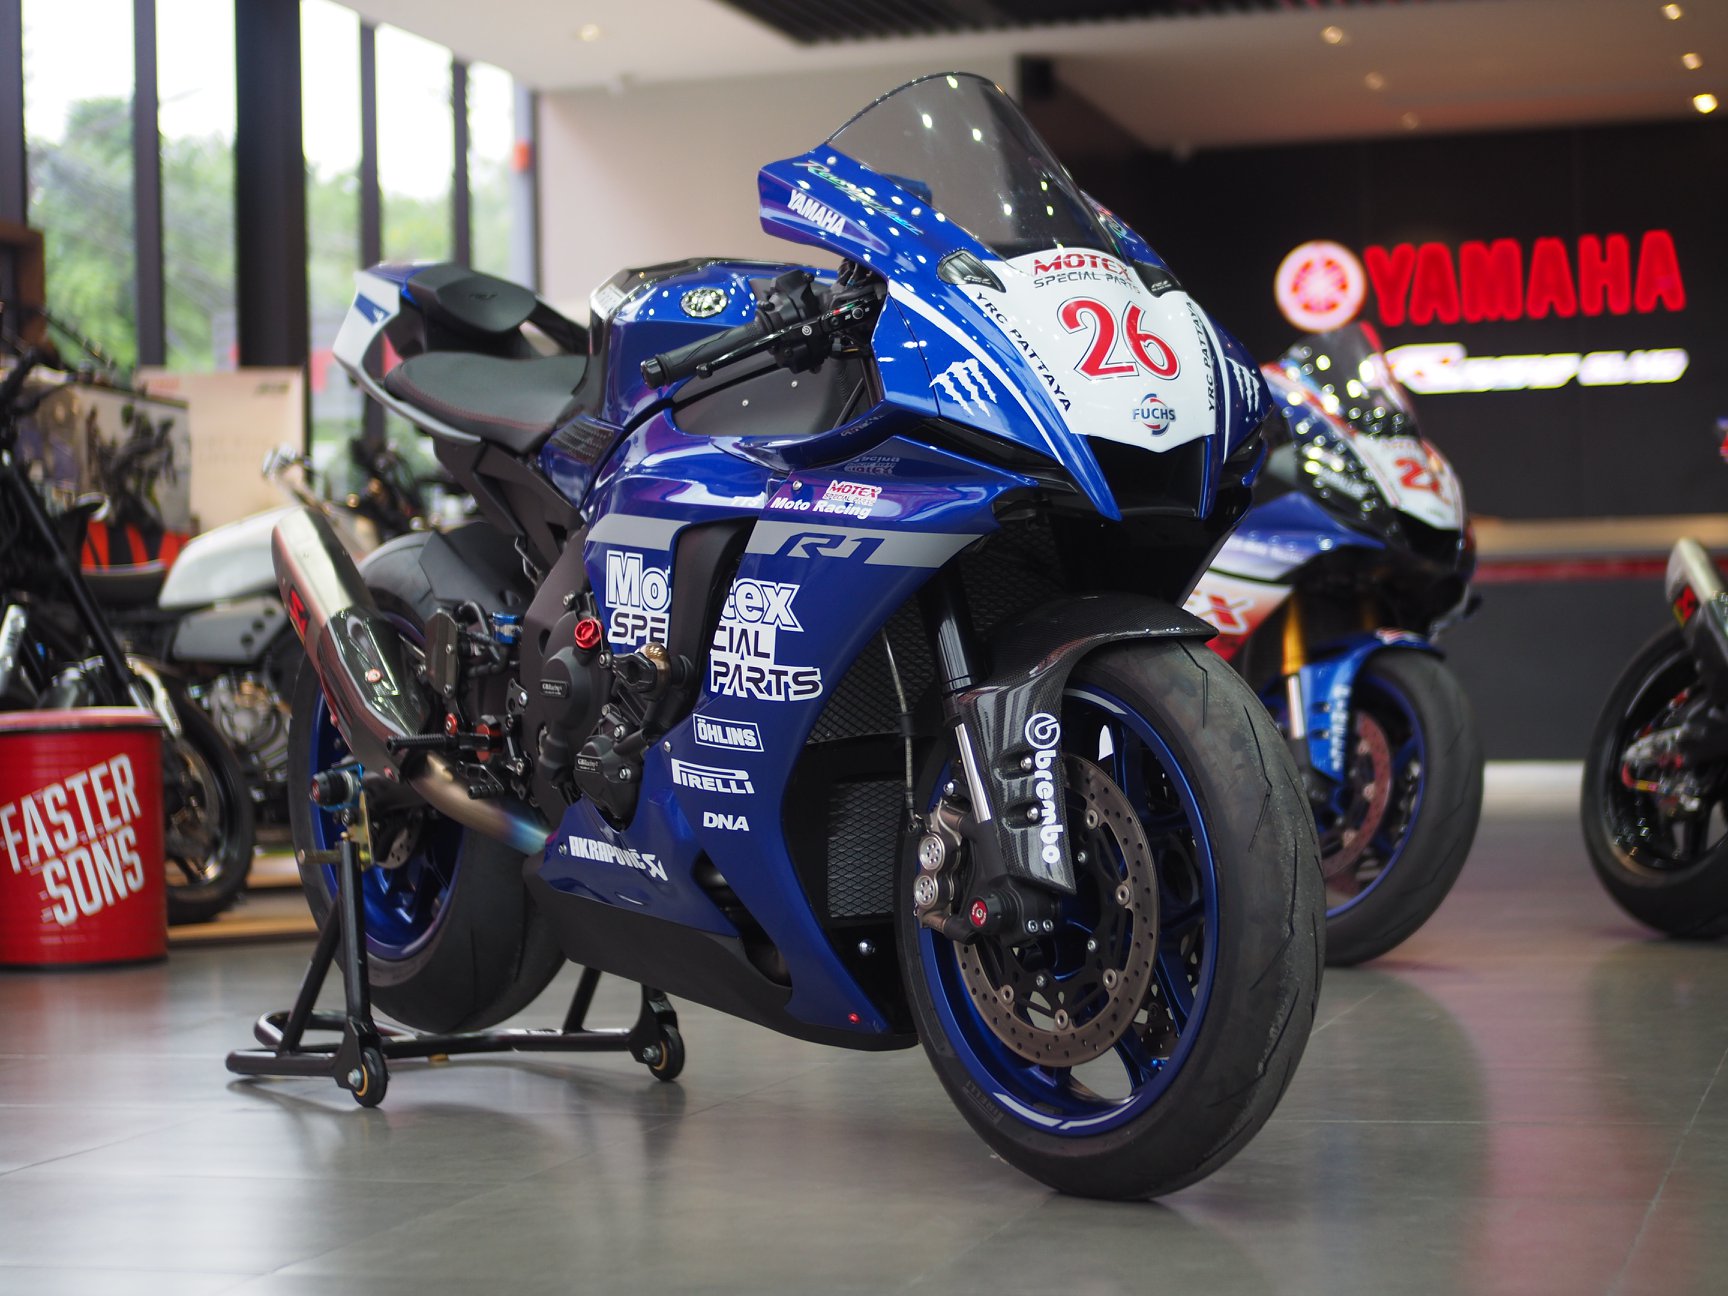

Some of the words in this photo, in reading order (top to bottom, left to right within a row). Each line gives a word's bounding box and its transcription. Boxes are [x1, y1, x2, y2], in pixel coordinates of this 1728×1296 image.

[787, 190, 846, 236] YAMAHA
[1033, 271, 1101, 288] SPECIAL
[1106, 274, 1141, 294] PARTS
[1034, 254, 1132, 282] MOTEX
[1364, 230, 1686, 326] YAMAHA
[976, 292, 1008, 324] YRC
[1010, 329, 1072, 412] PATTAYA
[1057, 296, 1180, 381] 26
[1206, 375, 1215, 411] YRC
[1132, 407, 1177, 422] FUCHS
[829, 481, 881, 498] MOTEX
[770, 497, 811, 511] Moto
[812, 499, 873, 519] Racing
[776, 532, 885, 563] R1
[713, 660, 820, 697] PARTS
[697, 719, 757, 747] ÖHLINS
[671, 758, 755, 794] PIRELLI
[0, 753, 142, 874] FASTER
[703, 812, 750, 831] DNA
[1034, 750, 1063, 864] brembo
[42, 826, 144, 927] SONS
